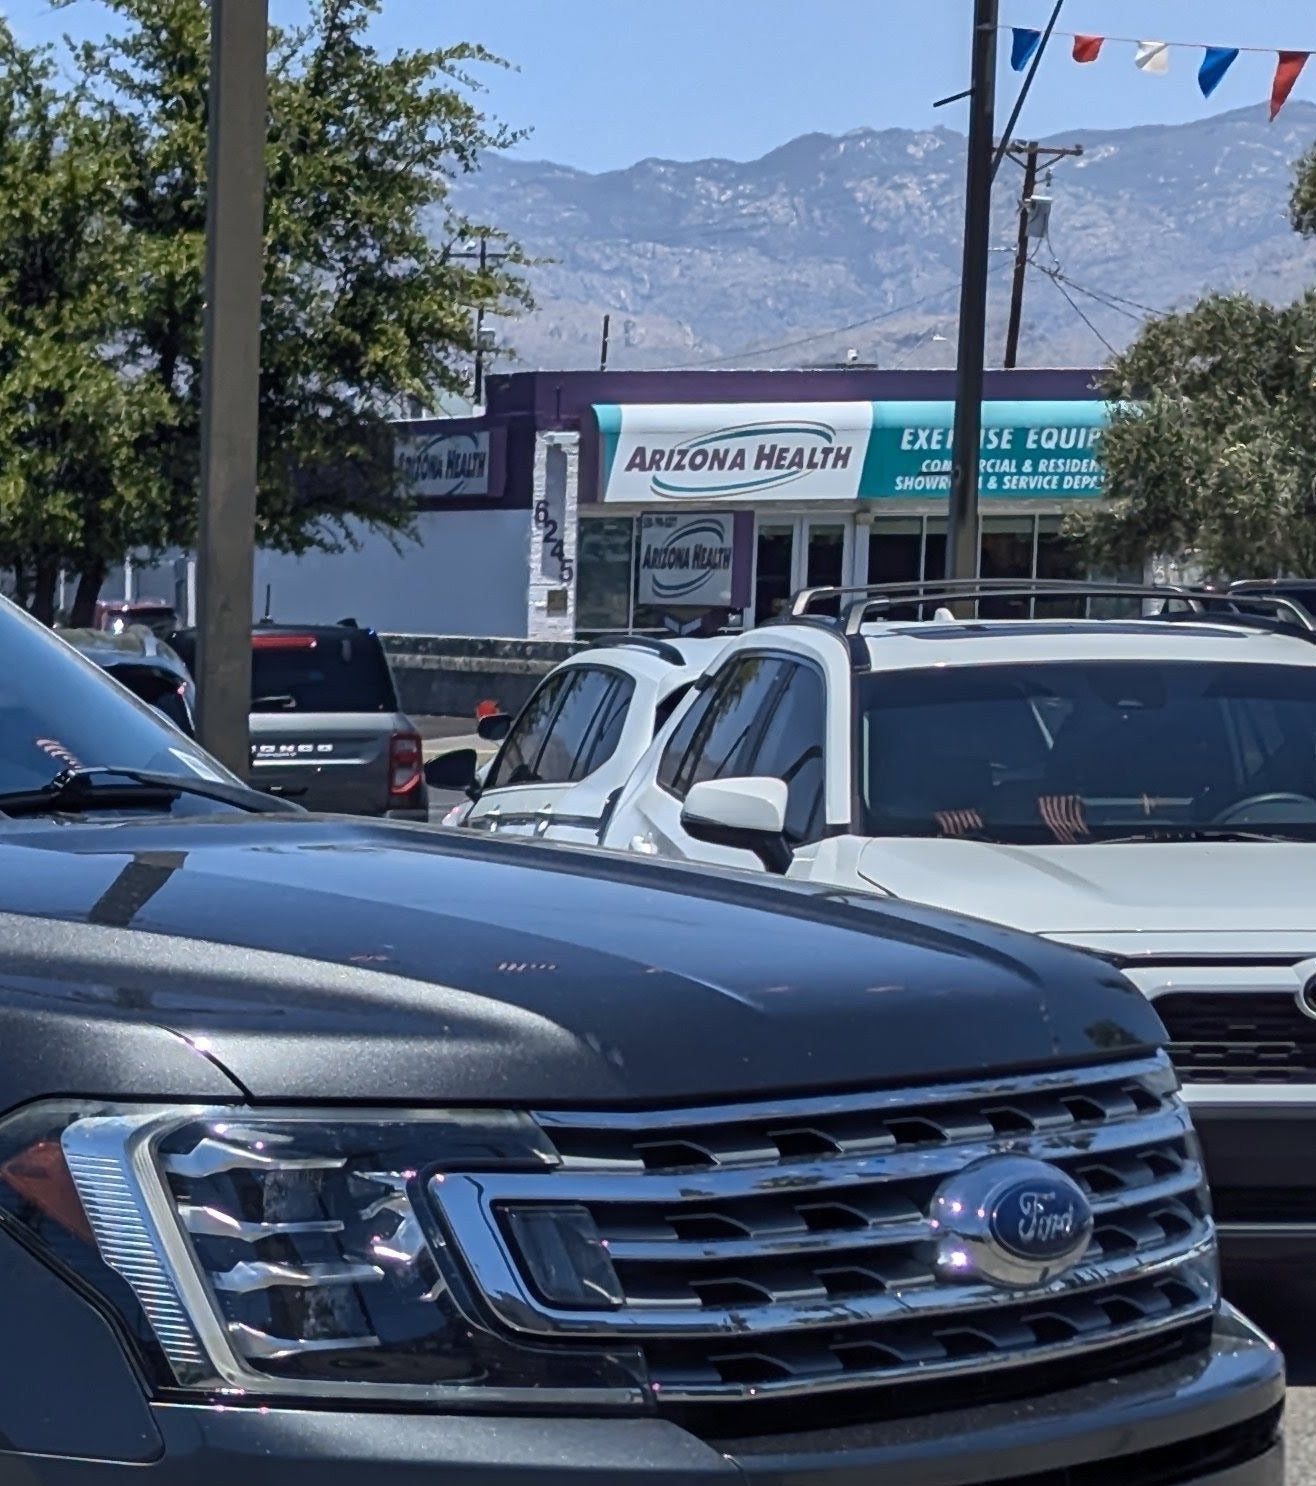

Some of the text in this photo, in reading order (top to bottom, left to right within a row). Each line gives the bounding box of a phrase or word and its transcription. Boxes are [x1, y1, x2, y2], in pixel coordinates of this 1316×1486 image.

[901, 428, 1014, 450] EXEISE
[624, 443, 853, 472] ARIZONA HEALTH
[921, 458, 1105, 473] COMRCIAL & RESIDEN
[895, 475, 983, 490] SHOWR
[986, 475, 998, 490] &
[1003, 475, 1059, 489] SERVICE
[535, 500, 574, 582] 6245
[641, 544, 732, 570] ARIZONA HEALTH
[1018, 1191, 1075, 1243] Ford
